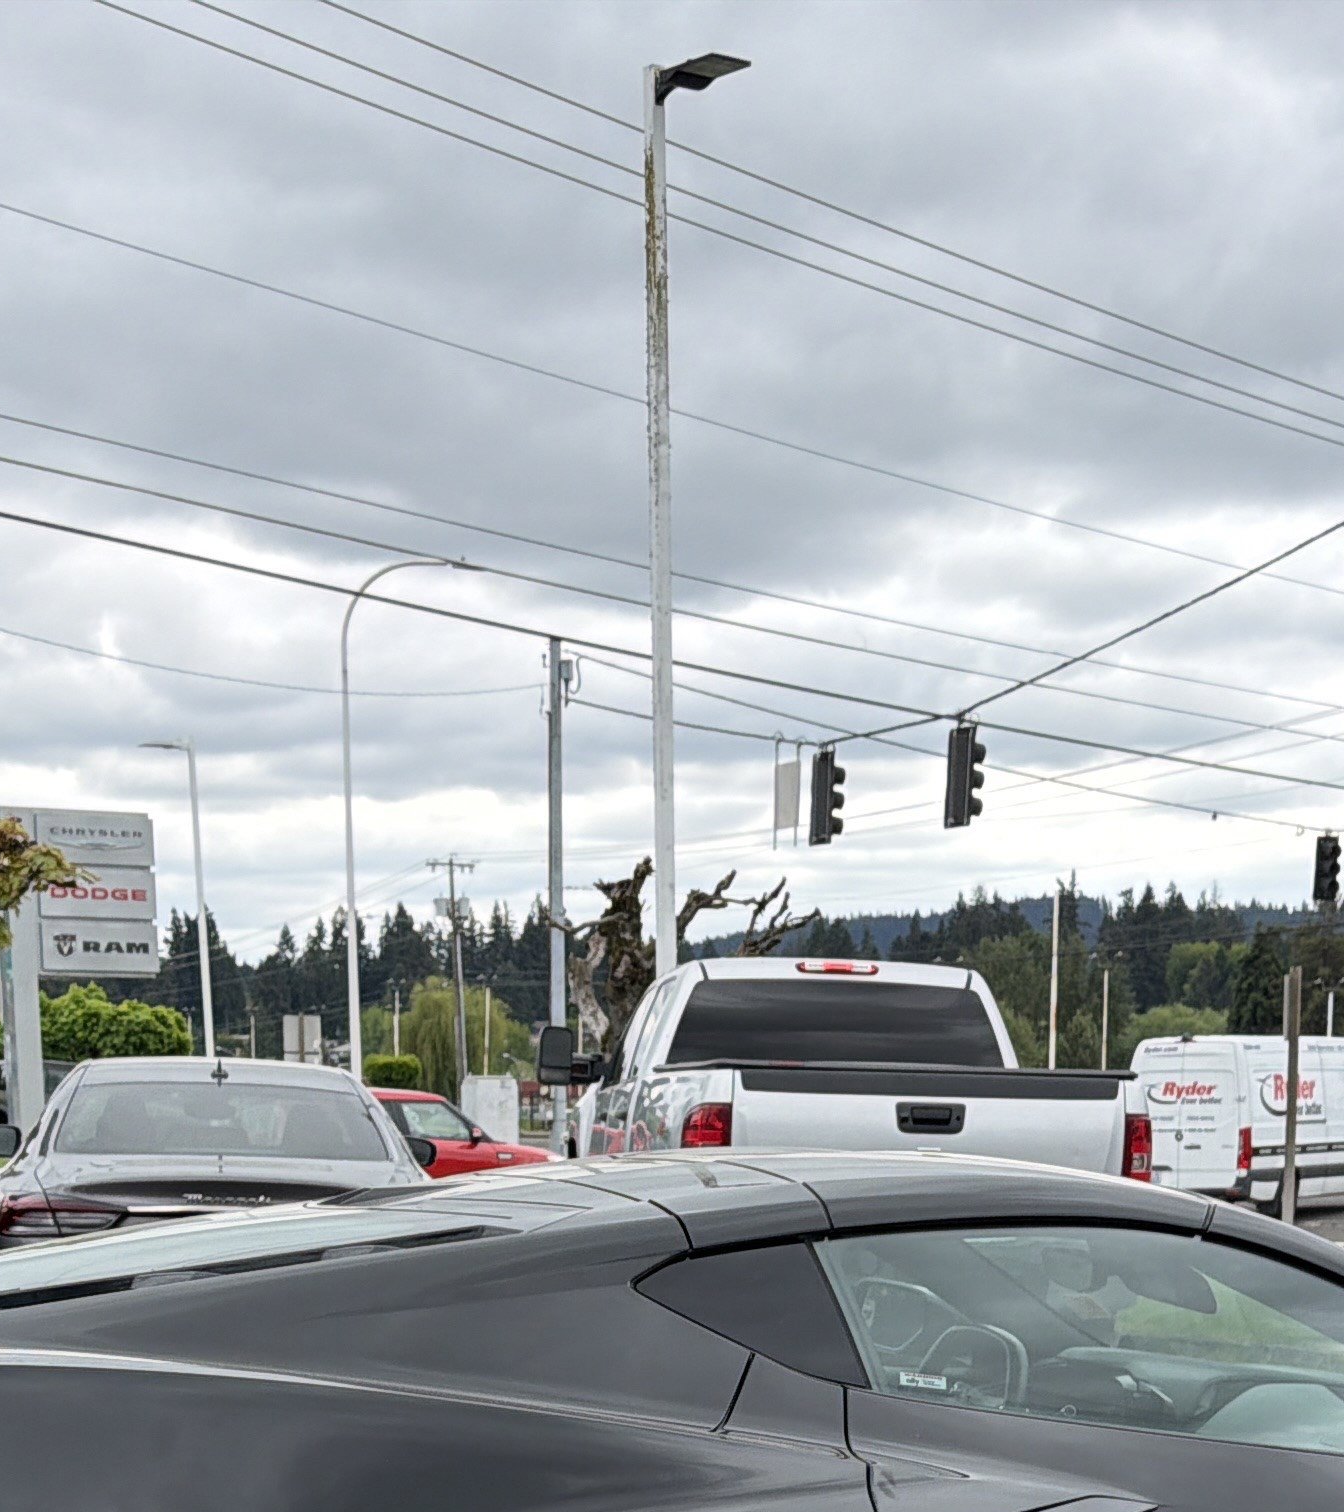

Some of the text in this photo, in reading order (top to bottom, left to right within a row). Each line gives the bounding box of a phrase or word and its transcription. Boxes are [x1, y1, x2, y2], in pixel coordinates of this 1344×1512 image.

[49, 826, 144, 838] CHRYSLER
[50, 885, 147, 902] DODGE
[82, 940, 150, 955] RAM
[1162, 1081, 1217, 1099] Ryder
[1273, 1073, 1316, 1100] Rer
